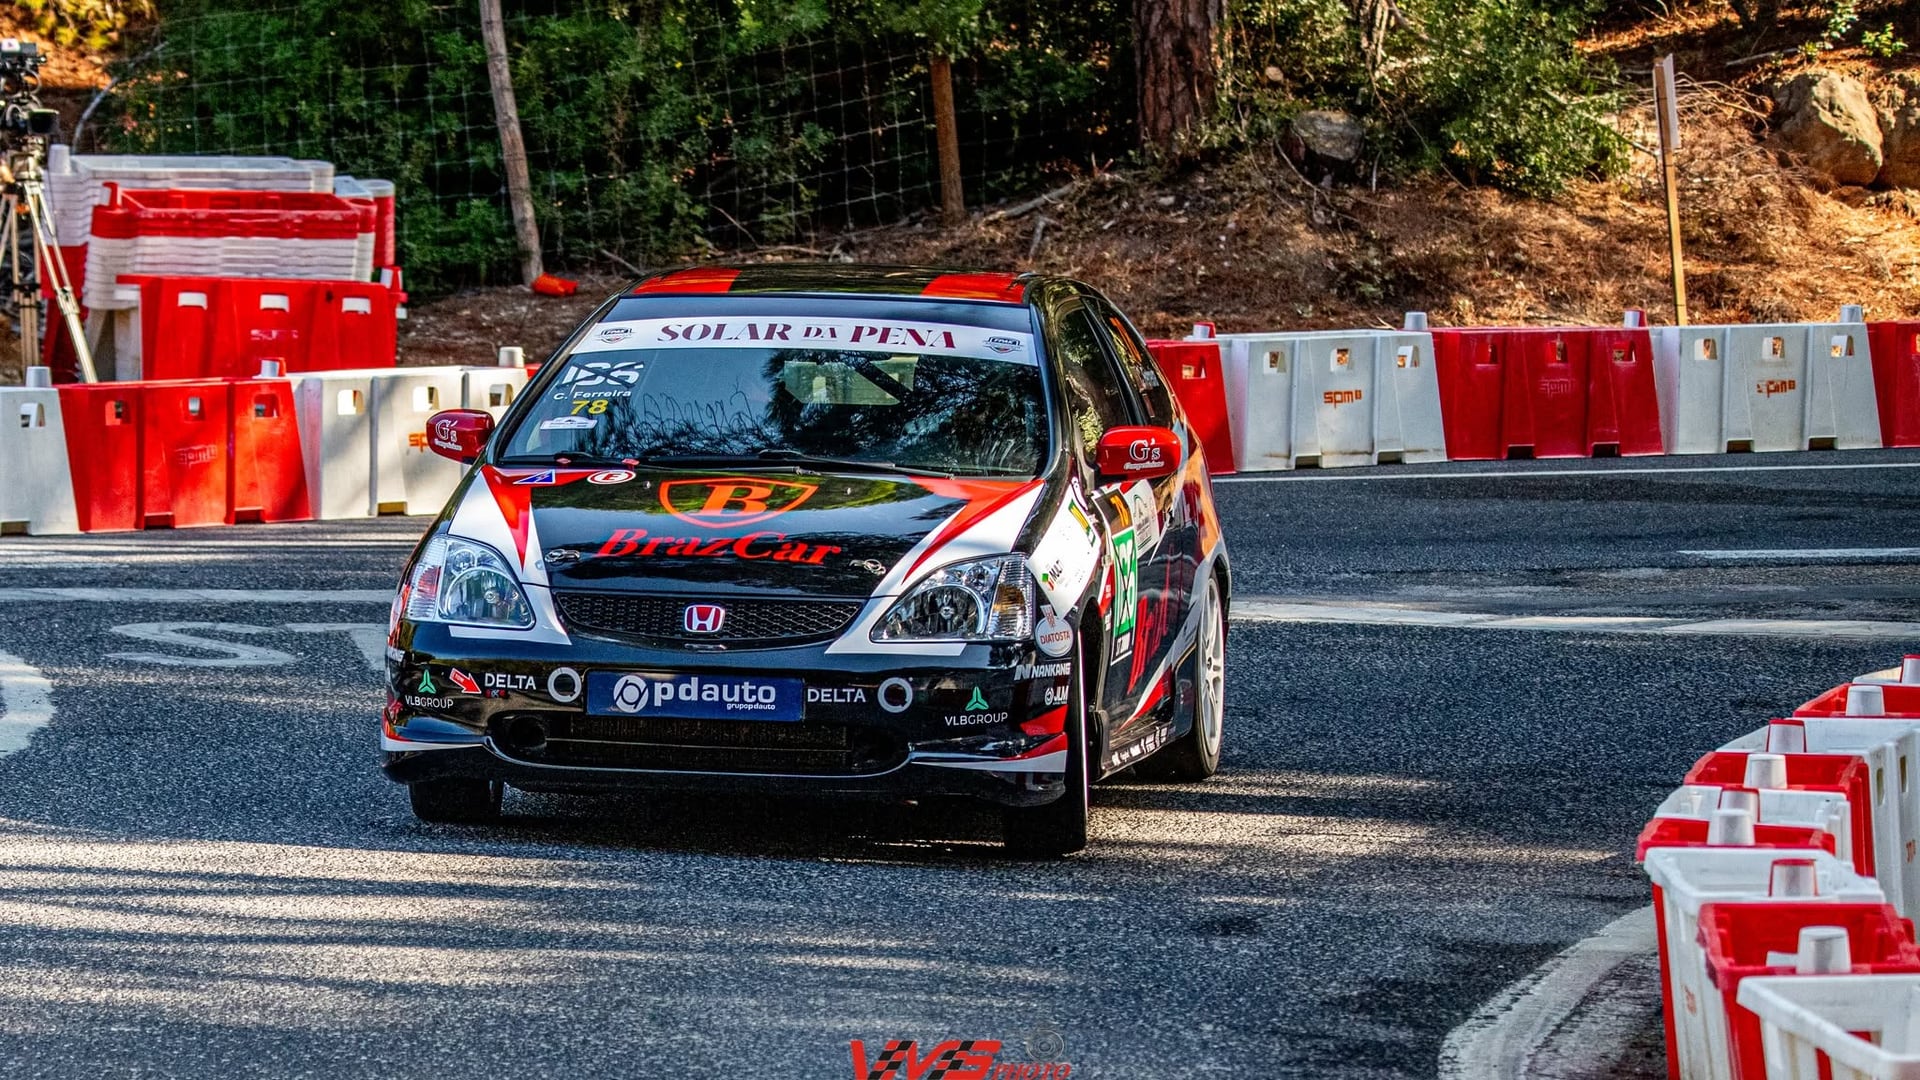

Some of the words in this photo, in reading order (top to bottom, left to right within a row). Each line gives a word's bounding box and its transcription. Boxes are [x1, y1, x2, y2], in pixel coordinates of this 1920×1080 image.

[657, 323, 792, 341] SOLAR
[803, 326, 837, 338] DA
[850, 326, 956, 348] PENA
[573, 389, 631, 399] Ferreira
[571, 399, 608, 416] 78
[1129, 438, 1161, 461] G's
[694, 484, 772, 517] B
[593, 528, 842, 566] BrazCar
[1031, 662, 1071, 679] NANKANG
[484, 672, 537, 690] DELTA
[654, 677, 776, 706] pdauto
[807, 688, 867, 703] DELTA
[404, 694, 454, 709] VLBGROUP
[726, 702, 776, 710] grupopdauto
[944, 712, 1008, 726] VLBGROUP
